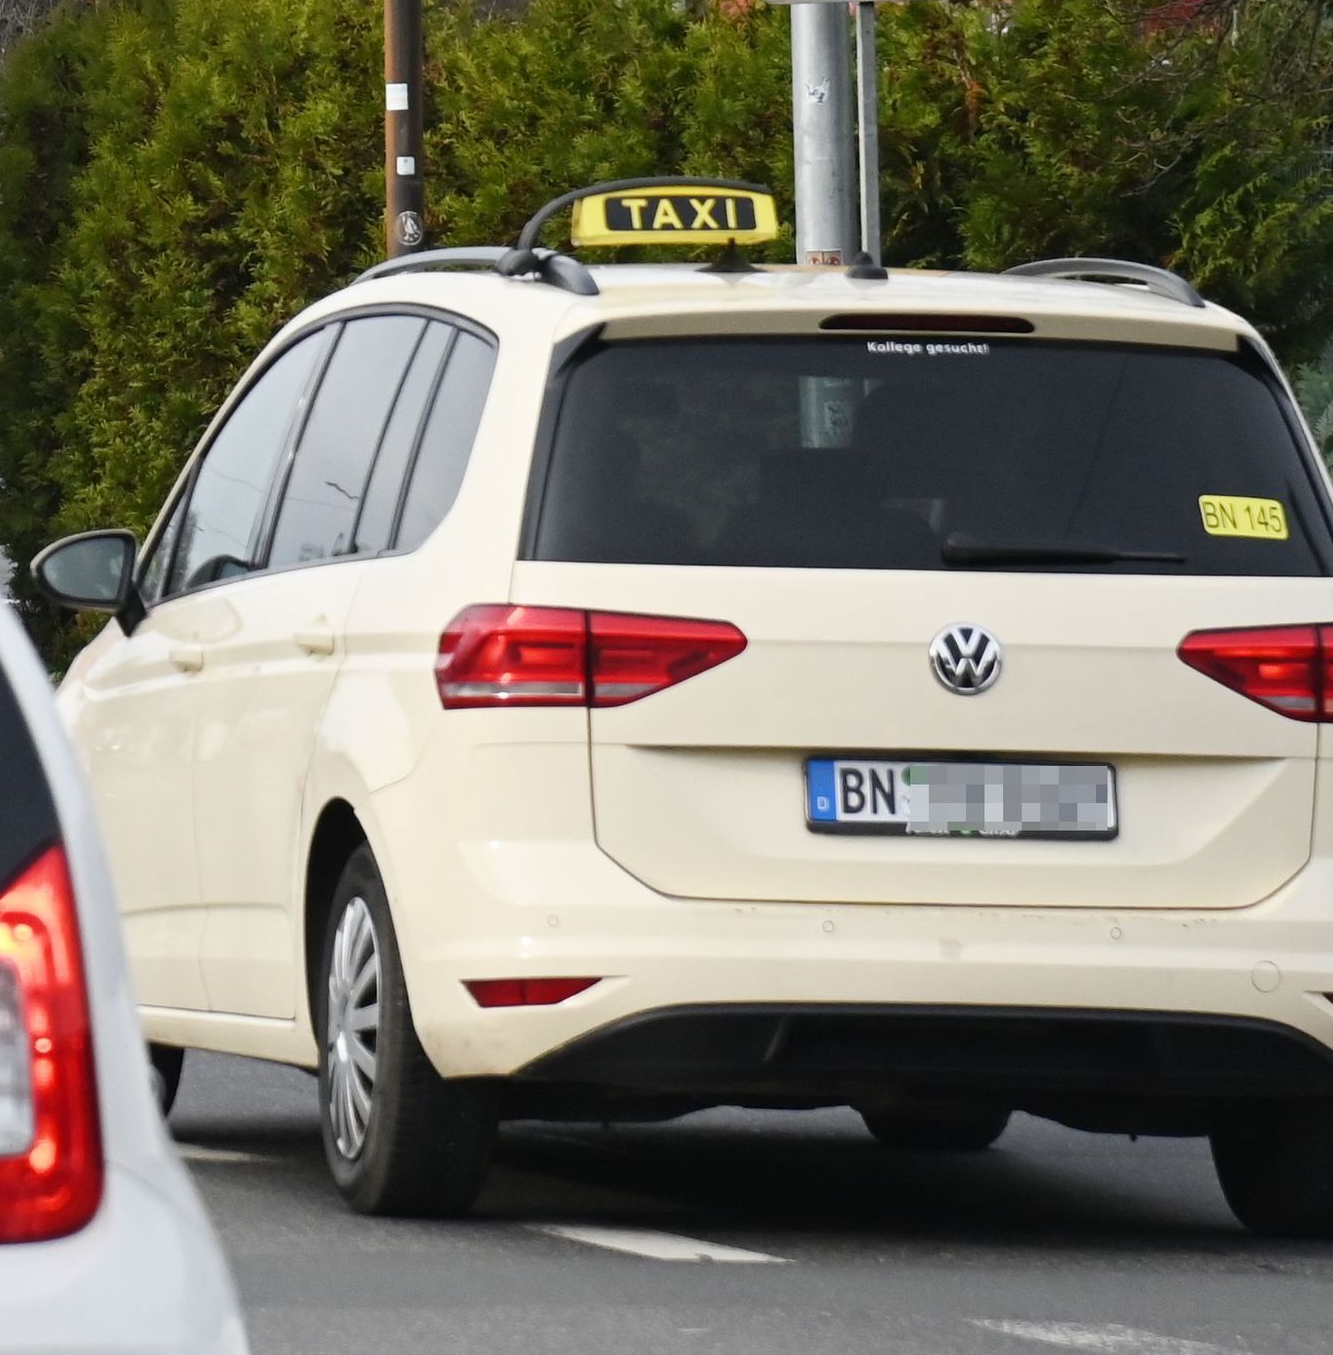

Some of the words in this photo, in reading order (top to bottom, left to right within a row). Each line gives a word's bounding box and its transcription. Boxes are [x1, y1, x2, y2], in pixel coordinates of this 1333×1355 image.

[621, 198, 739, 230] TAXI
[866, 341, 922, 356] Kollege
[926, 342, 990, 356] gesucht!
[1202, 502, 1237, 529] BN
[1243, 505, 1282, 533] 145
[839, 767, 896, 815] BN
